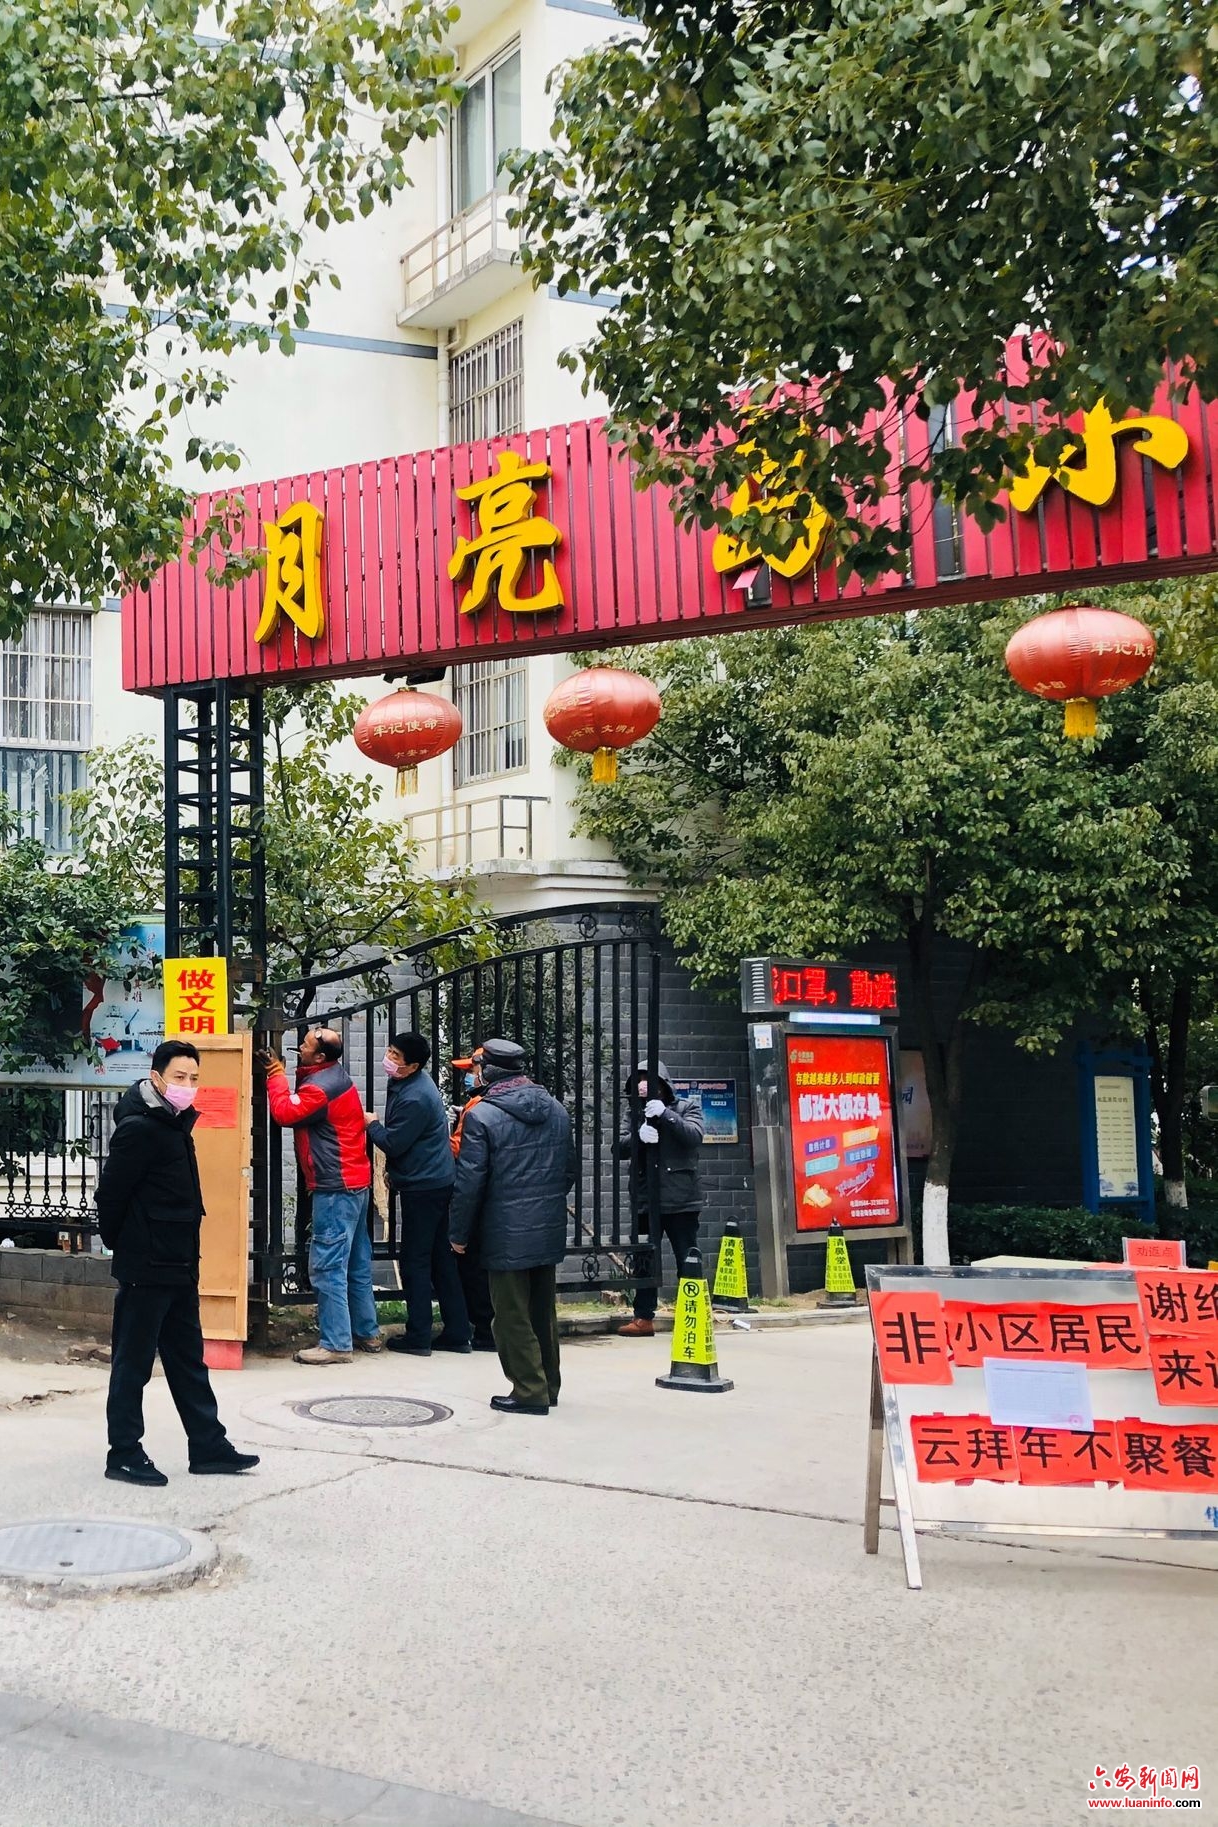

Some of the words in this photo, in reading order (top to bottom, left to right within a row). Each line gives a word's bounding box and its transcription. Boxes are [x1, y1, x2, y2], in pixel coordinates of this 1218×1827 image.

[374, 718, 439, 737] 牢记使命
[177, 969, 215, 1034] 做文明
[798, 1092, 882, 1123] 邮政大额存单
[1136, 1246, 1174, 1257] 劝返点
[683, 1300, 698, 1360] 请勿泊车
[917, 1427, 1218, 1479] 云拜年不聚餐
